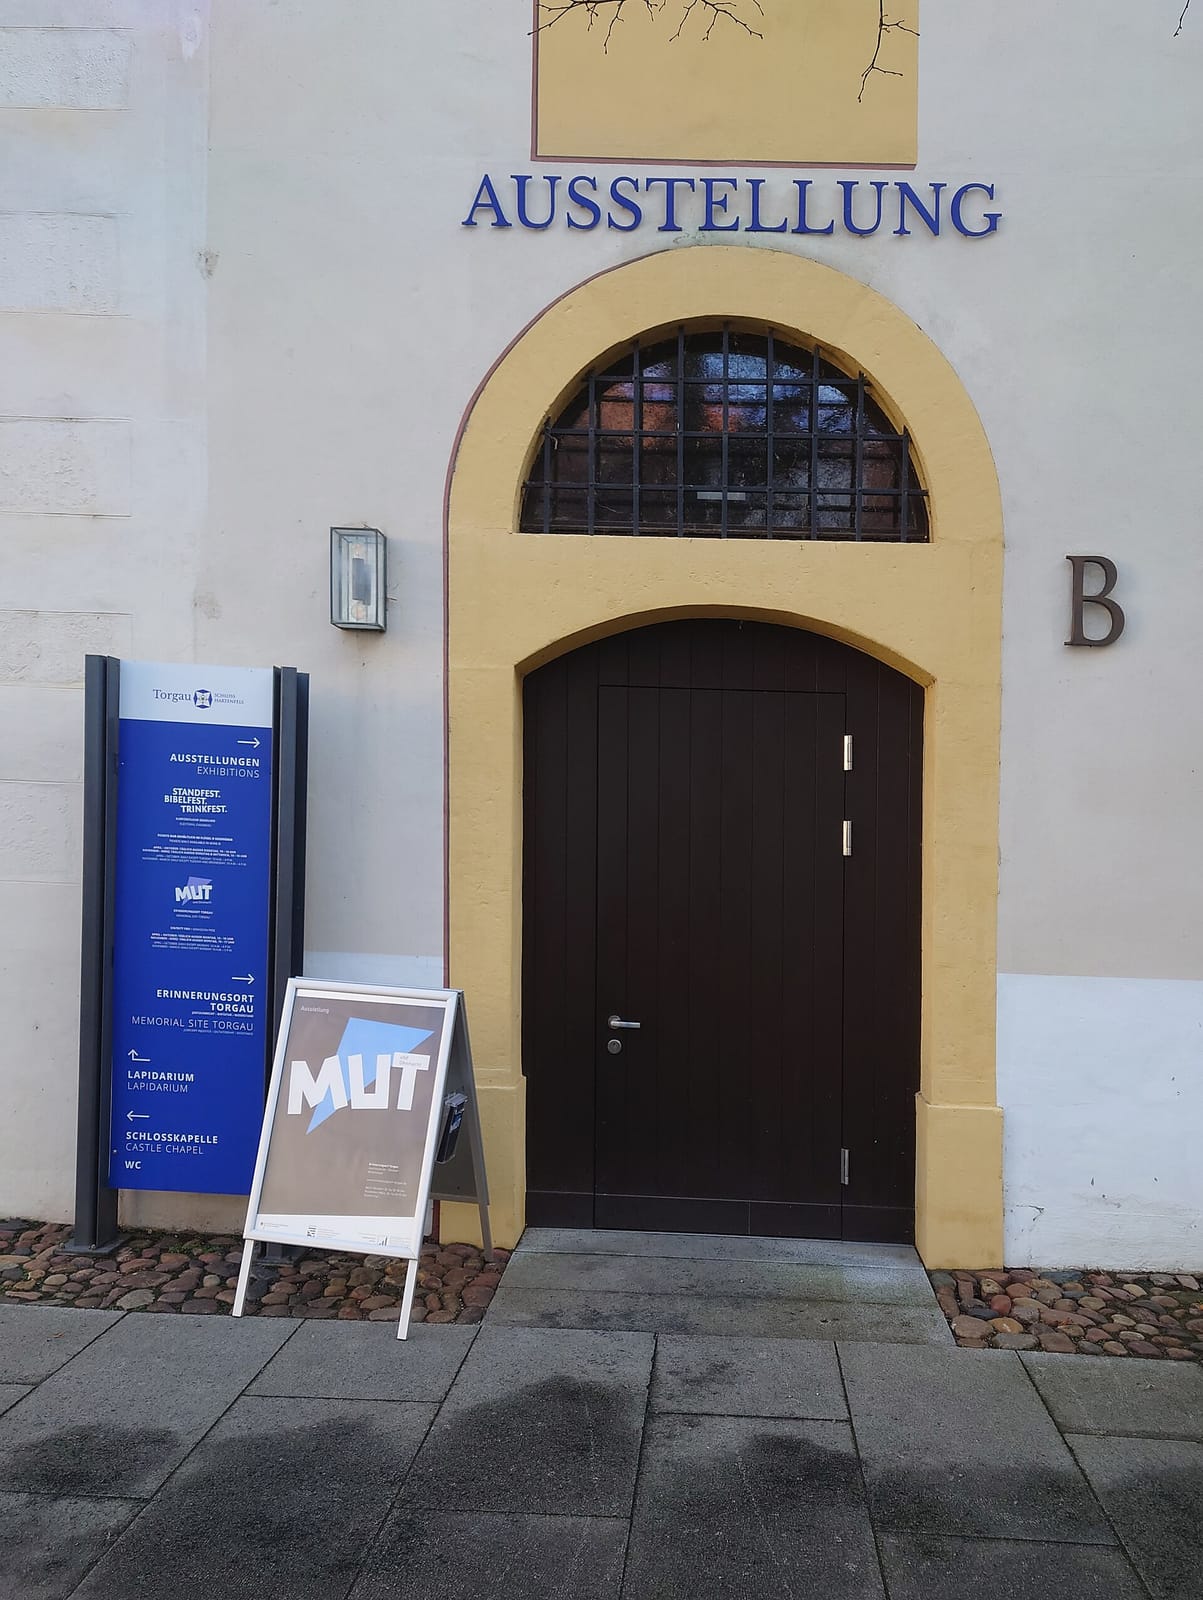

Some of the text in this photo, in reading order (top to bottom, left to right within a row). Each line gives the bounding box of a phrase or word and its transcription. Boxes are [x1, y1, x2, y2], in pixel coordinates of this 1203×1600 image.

[462, 173, 1004, 238] AUSSTELLUNG
[1064, 555, 1126, 648] B
[153, 689, 191, 702] Torgau
[169, 753, 260, 767] AUSSTELLUNGEN
[197, 766, 260, 778] EXHIBITIONS
[172, 788, 221, 798] STANDFEST.
[164, 795, 208, 805] BIBELFEST.
[180, 805, 228, 813] TRINKFEST.
[175, 884, 213, 902] MUT
[156, 989, 255, 1003] ERINNERUNGSORT
[210, 1002, 254, 1013] TORGAU
[300, 1005, 330, 1015] Ausstellung
[131, 1015, 254, 1031] MEMORIAL SITE TORGAU
[127, 1070, 194, 1082] LAPIDARIUM
[127, 1082, 188, 1093] LAPIDARIUM
[287, 1051, 431, 1115] MUT
[126, 1131, 219, 1144] SCHLOSSKAPELLE
[125, 1142, 204, 1155] CASTLE CHAPEL
[125, 1160, 142, 1170] WC
